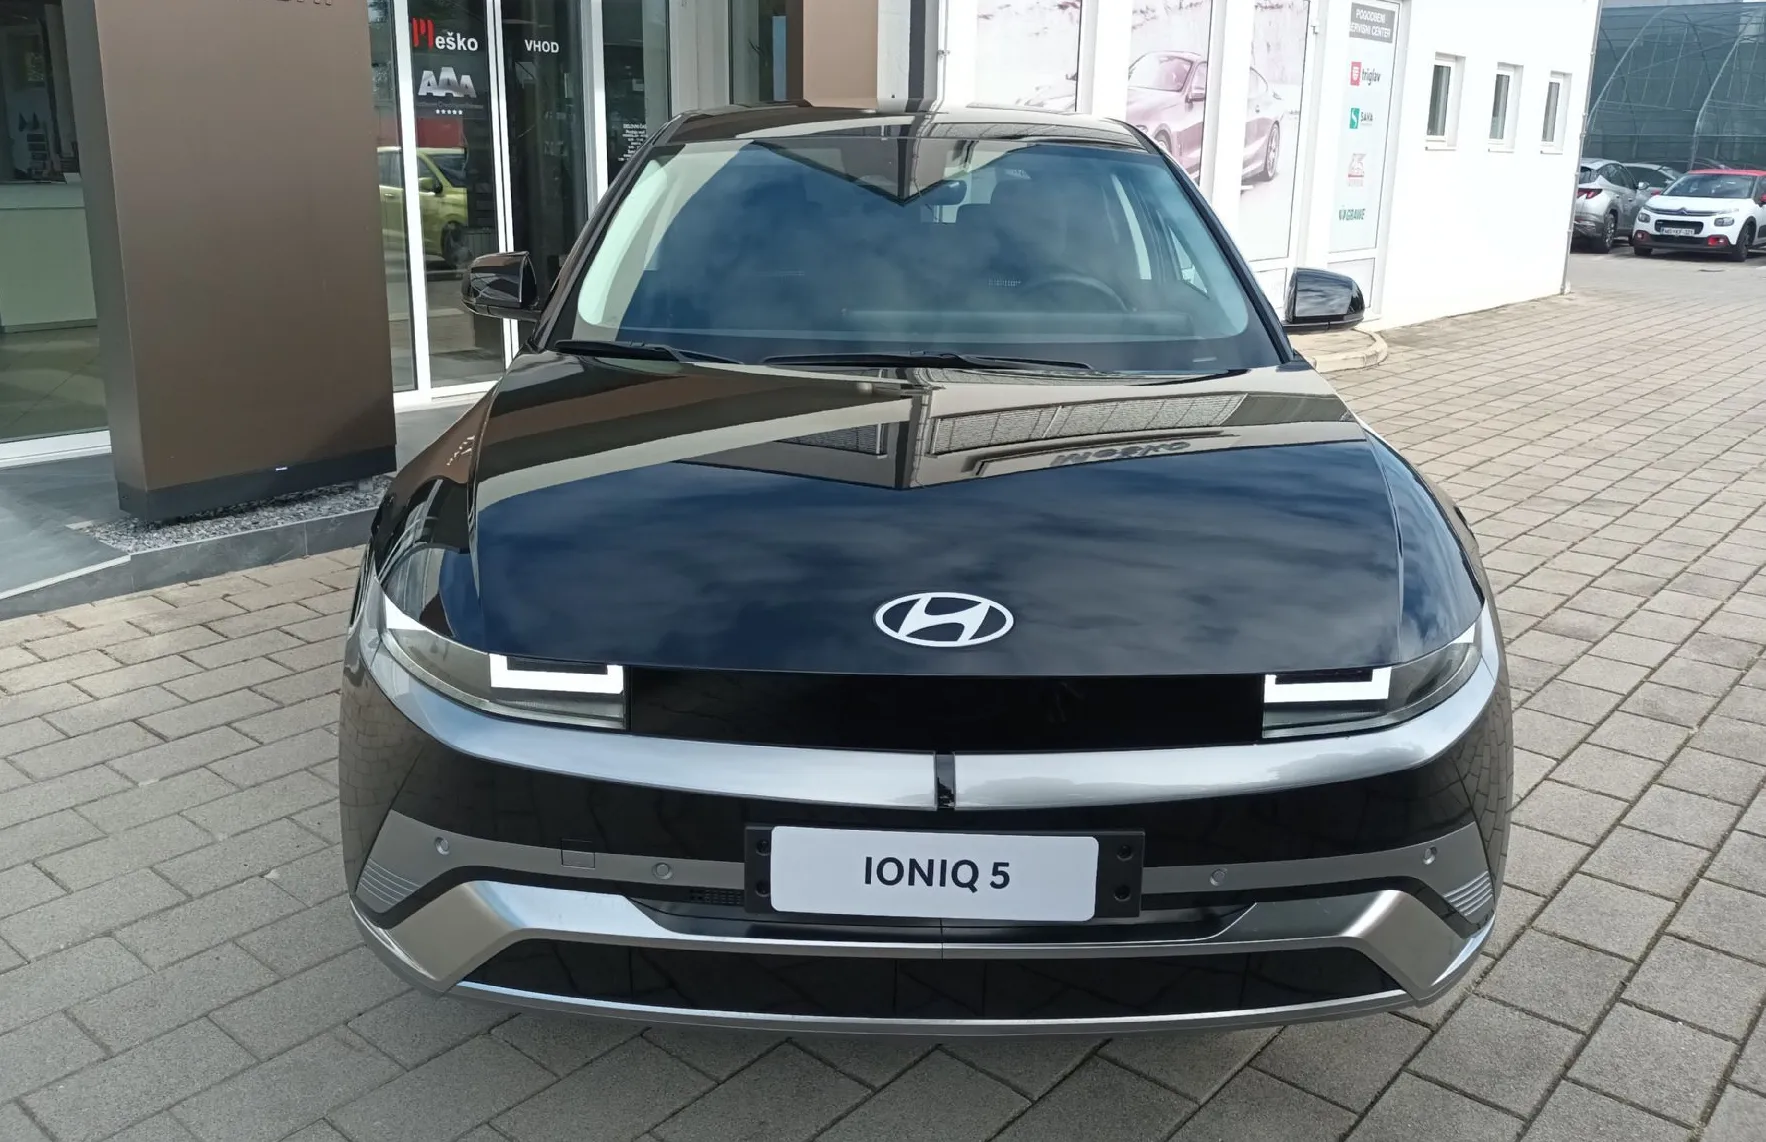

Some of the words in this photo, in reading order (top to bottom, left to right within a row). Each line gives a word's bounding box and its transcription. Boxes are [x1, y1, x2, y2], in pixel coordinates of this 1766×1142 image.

[412, 17, 478, 52] Meško
[525, 39, 560, 53] VHOD
[1371, 26, 1391, 38] CENTER
[418, 66, 477, 98] AAA
[865, 856, 979, 893] IONIQ
[989, 861, 1010, 889] 5
